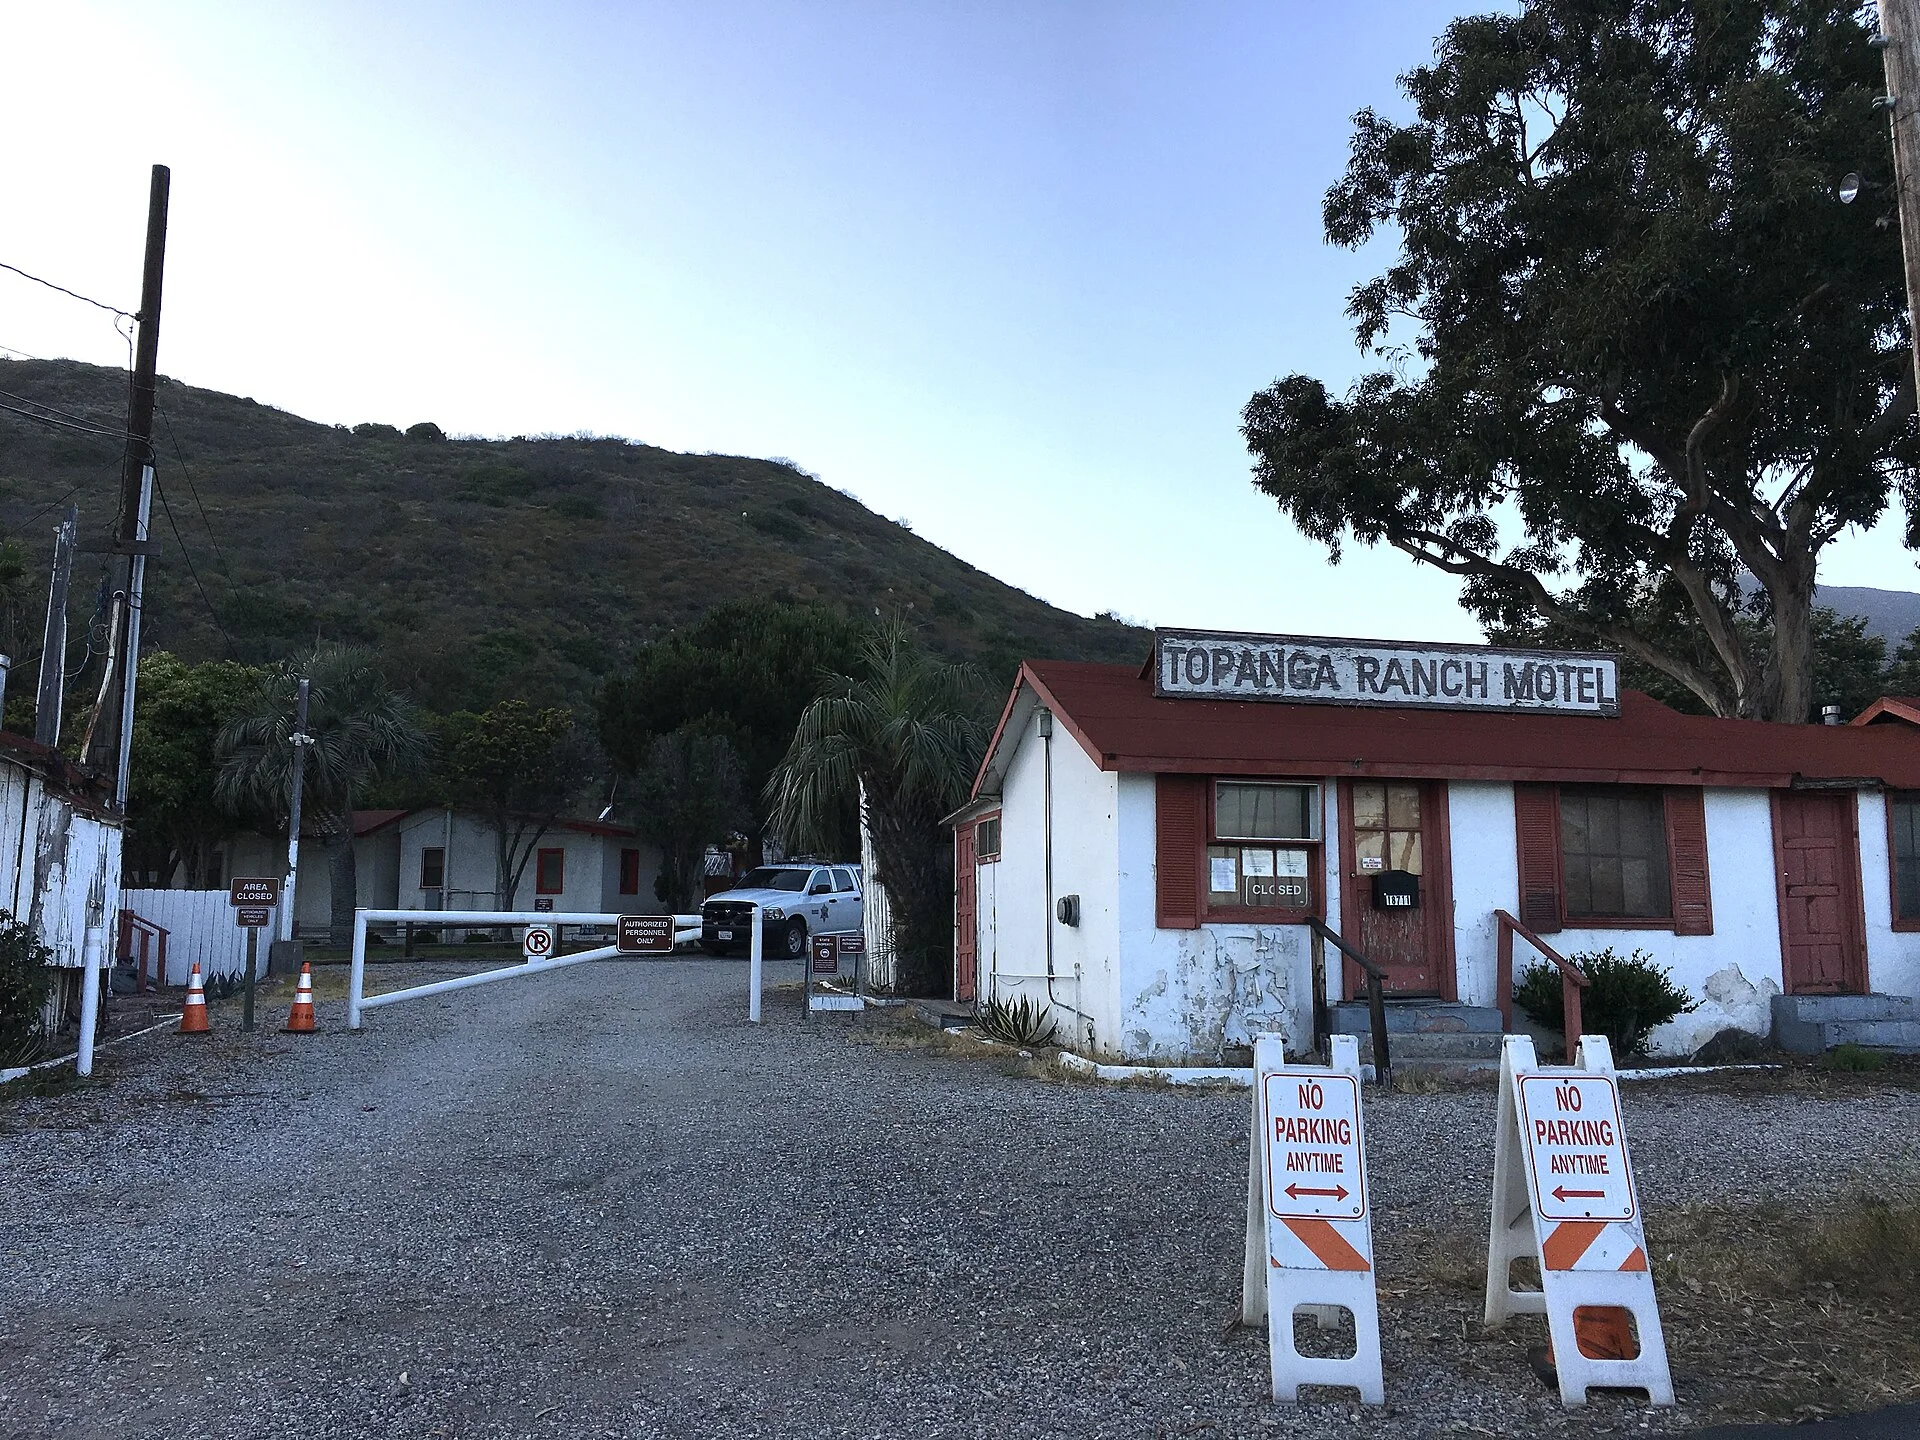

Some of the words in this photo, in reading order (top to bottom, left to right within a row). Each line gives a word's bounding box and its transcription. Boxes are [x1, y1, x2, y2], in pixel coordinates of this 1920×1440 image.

[1163, 645, 1344, 691] TOPANGA
[1356, 655, 1488, 699] RANCH
[1502, 661, 1617, 704] MOTEL
[236, 892, 273, 900] CLOSED
[243, 883, 268, 891] AREA
[1252, 884, 1302, 895] CLOSED
[1386, 894, 1411, 906] 18711
[625, 920, 668, 928] AUTHORIZED
[636, 937, 655, 945] ONLY
[1298, 1084, 1324, 1110] NO
[1555, 1086, 1582, 1112] NO
[1275, 1117, 1351, 1145] PARKING
[1535, 1119, 1615, 1146] PARKING
[1286, 1152, 1344, 1174] ANYTIME
[1551, 1154, 1610, 1175] ANYTIME
